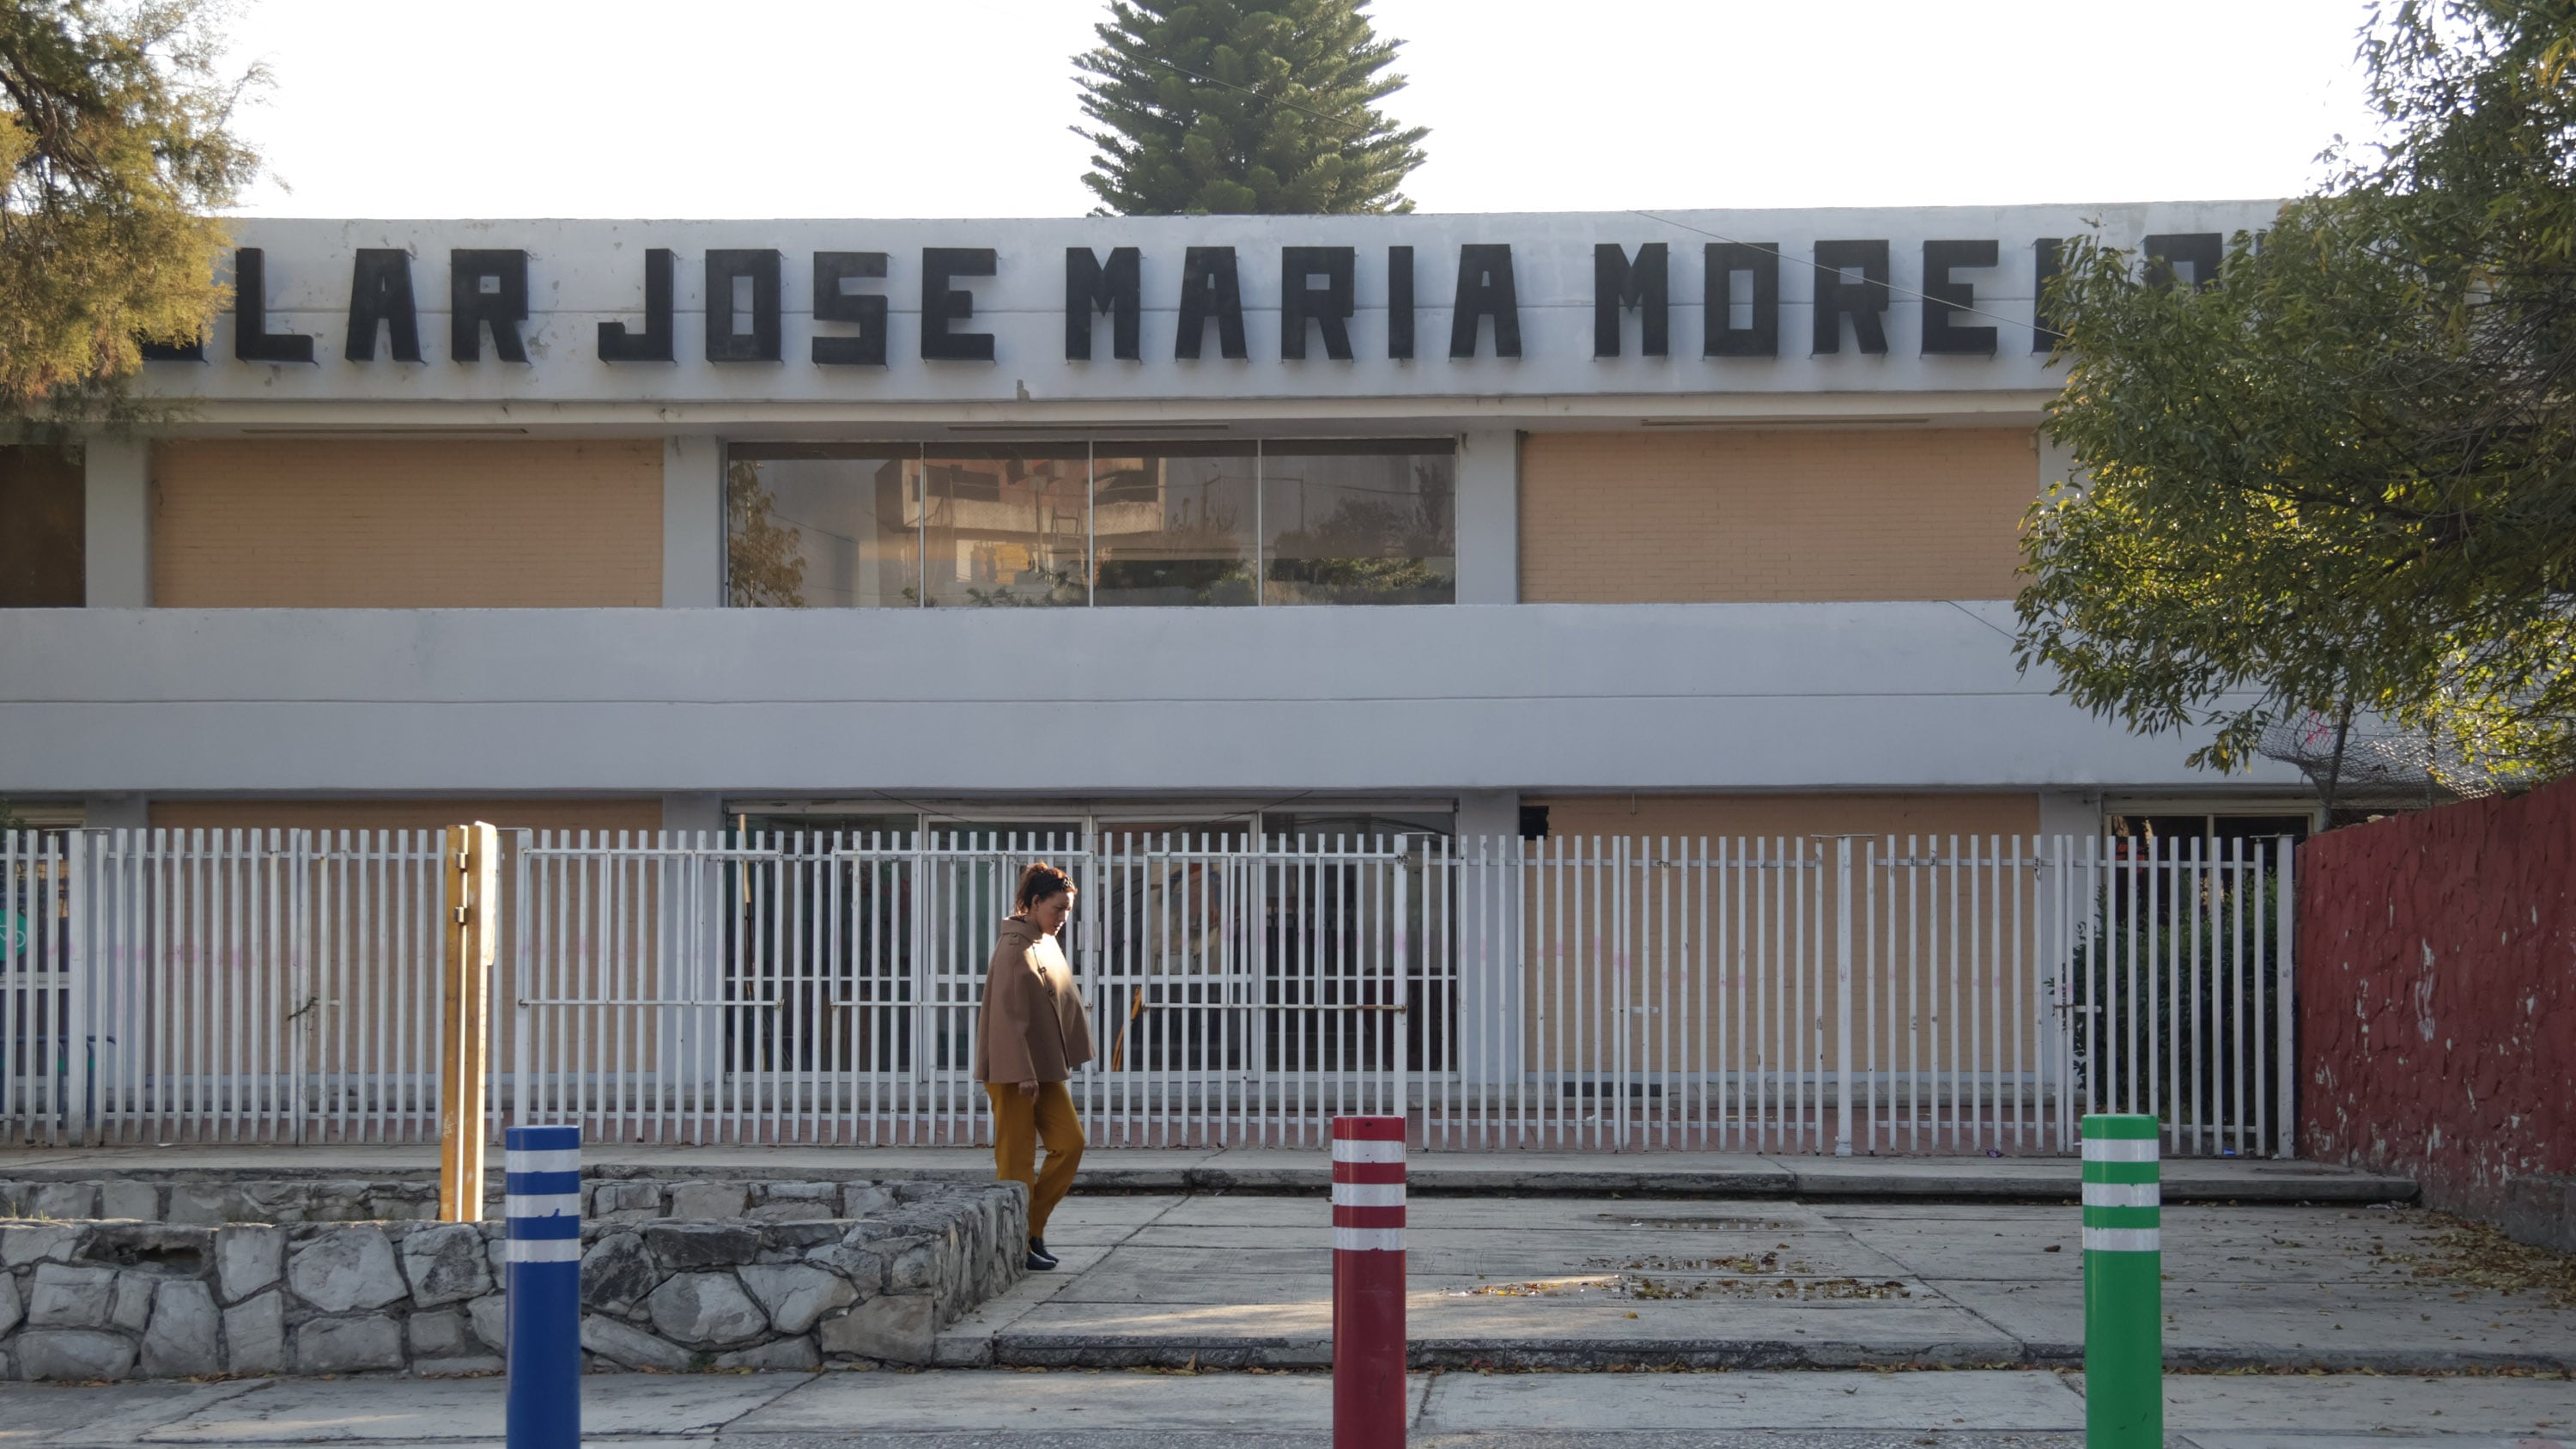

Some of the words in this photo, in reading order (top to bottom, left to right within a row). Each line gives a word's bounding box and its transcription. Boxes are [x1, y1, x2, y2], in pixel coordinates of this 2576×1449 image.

[140, 247, 529, 362] LAR
[598, 247, 997, 365] JOSE
[1066, 244, 1522, 360] MARIA
